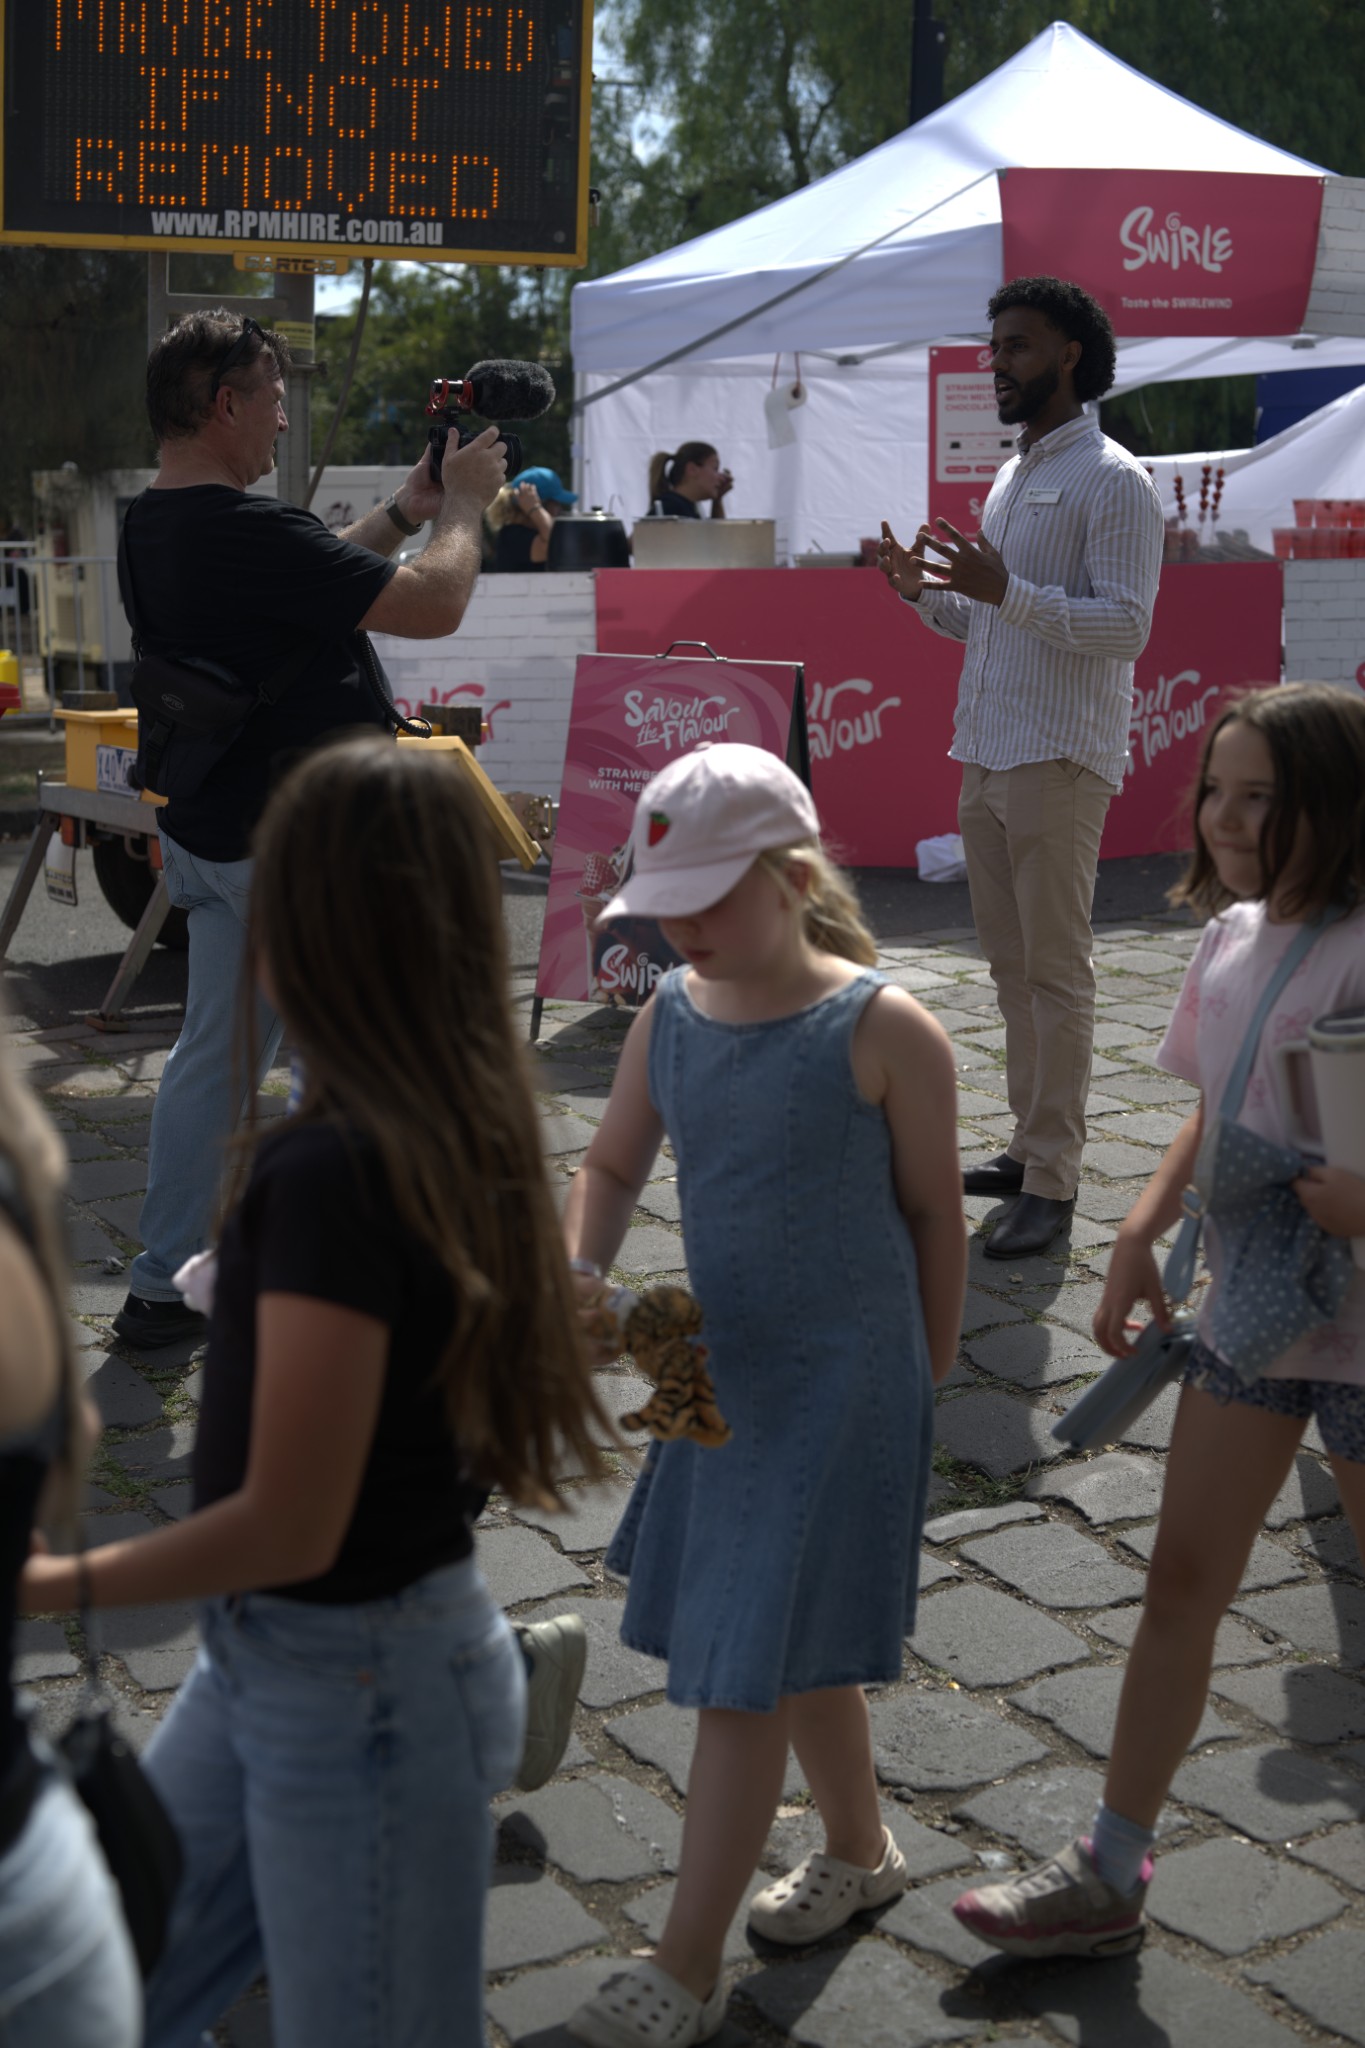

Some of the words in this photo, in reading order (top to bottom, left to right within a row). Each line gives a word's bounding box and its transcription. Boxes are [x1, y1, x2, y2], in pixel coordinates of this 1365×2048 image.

[57, 0, 272, 59] MAYBE
[311, 0, 533, 71] TOWED
[140, 66, 229, 130] IF
[266, 73, 439, 140] NOT
[76, 138, 499, 219] REMOVED
[151, 209, 443, 246] www.RPMHIRE.com.au
[1152, 298, 1170, 309] the
[624, 689, 727, 727] Savour
[636, 722, 659, 743] the
[659, 706, 740, 750] Flavour
[588, 779, 621, 791] WITH
[601, 944, 673, 996] SWIR
